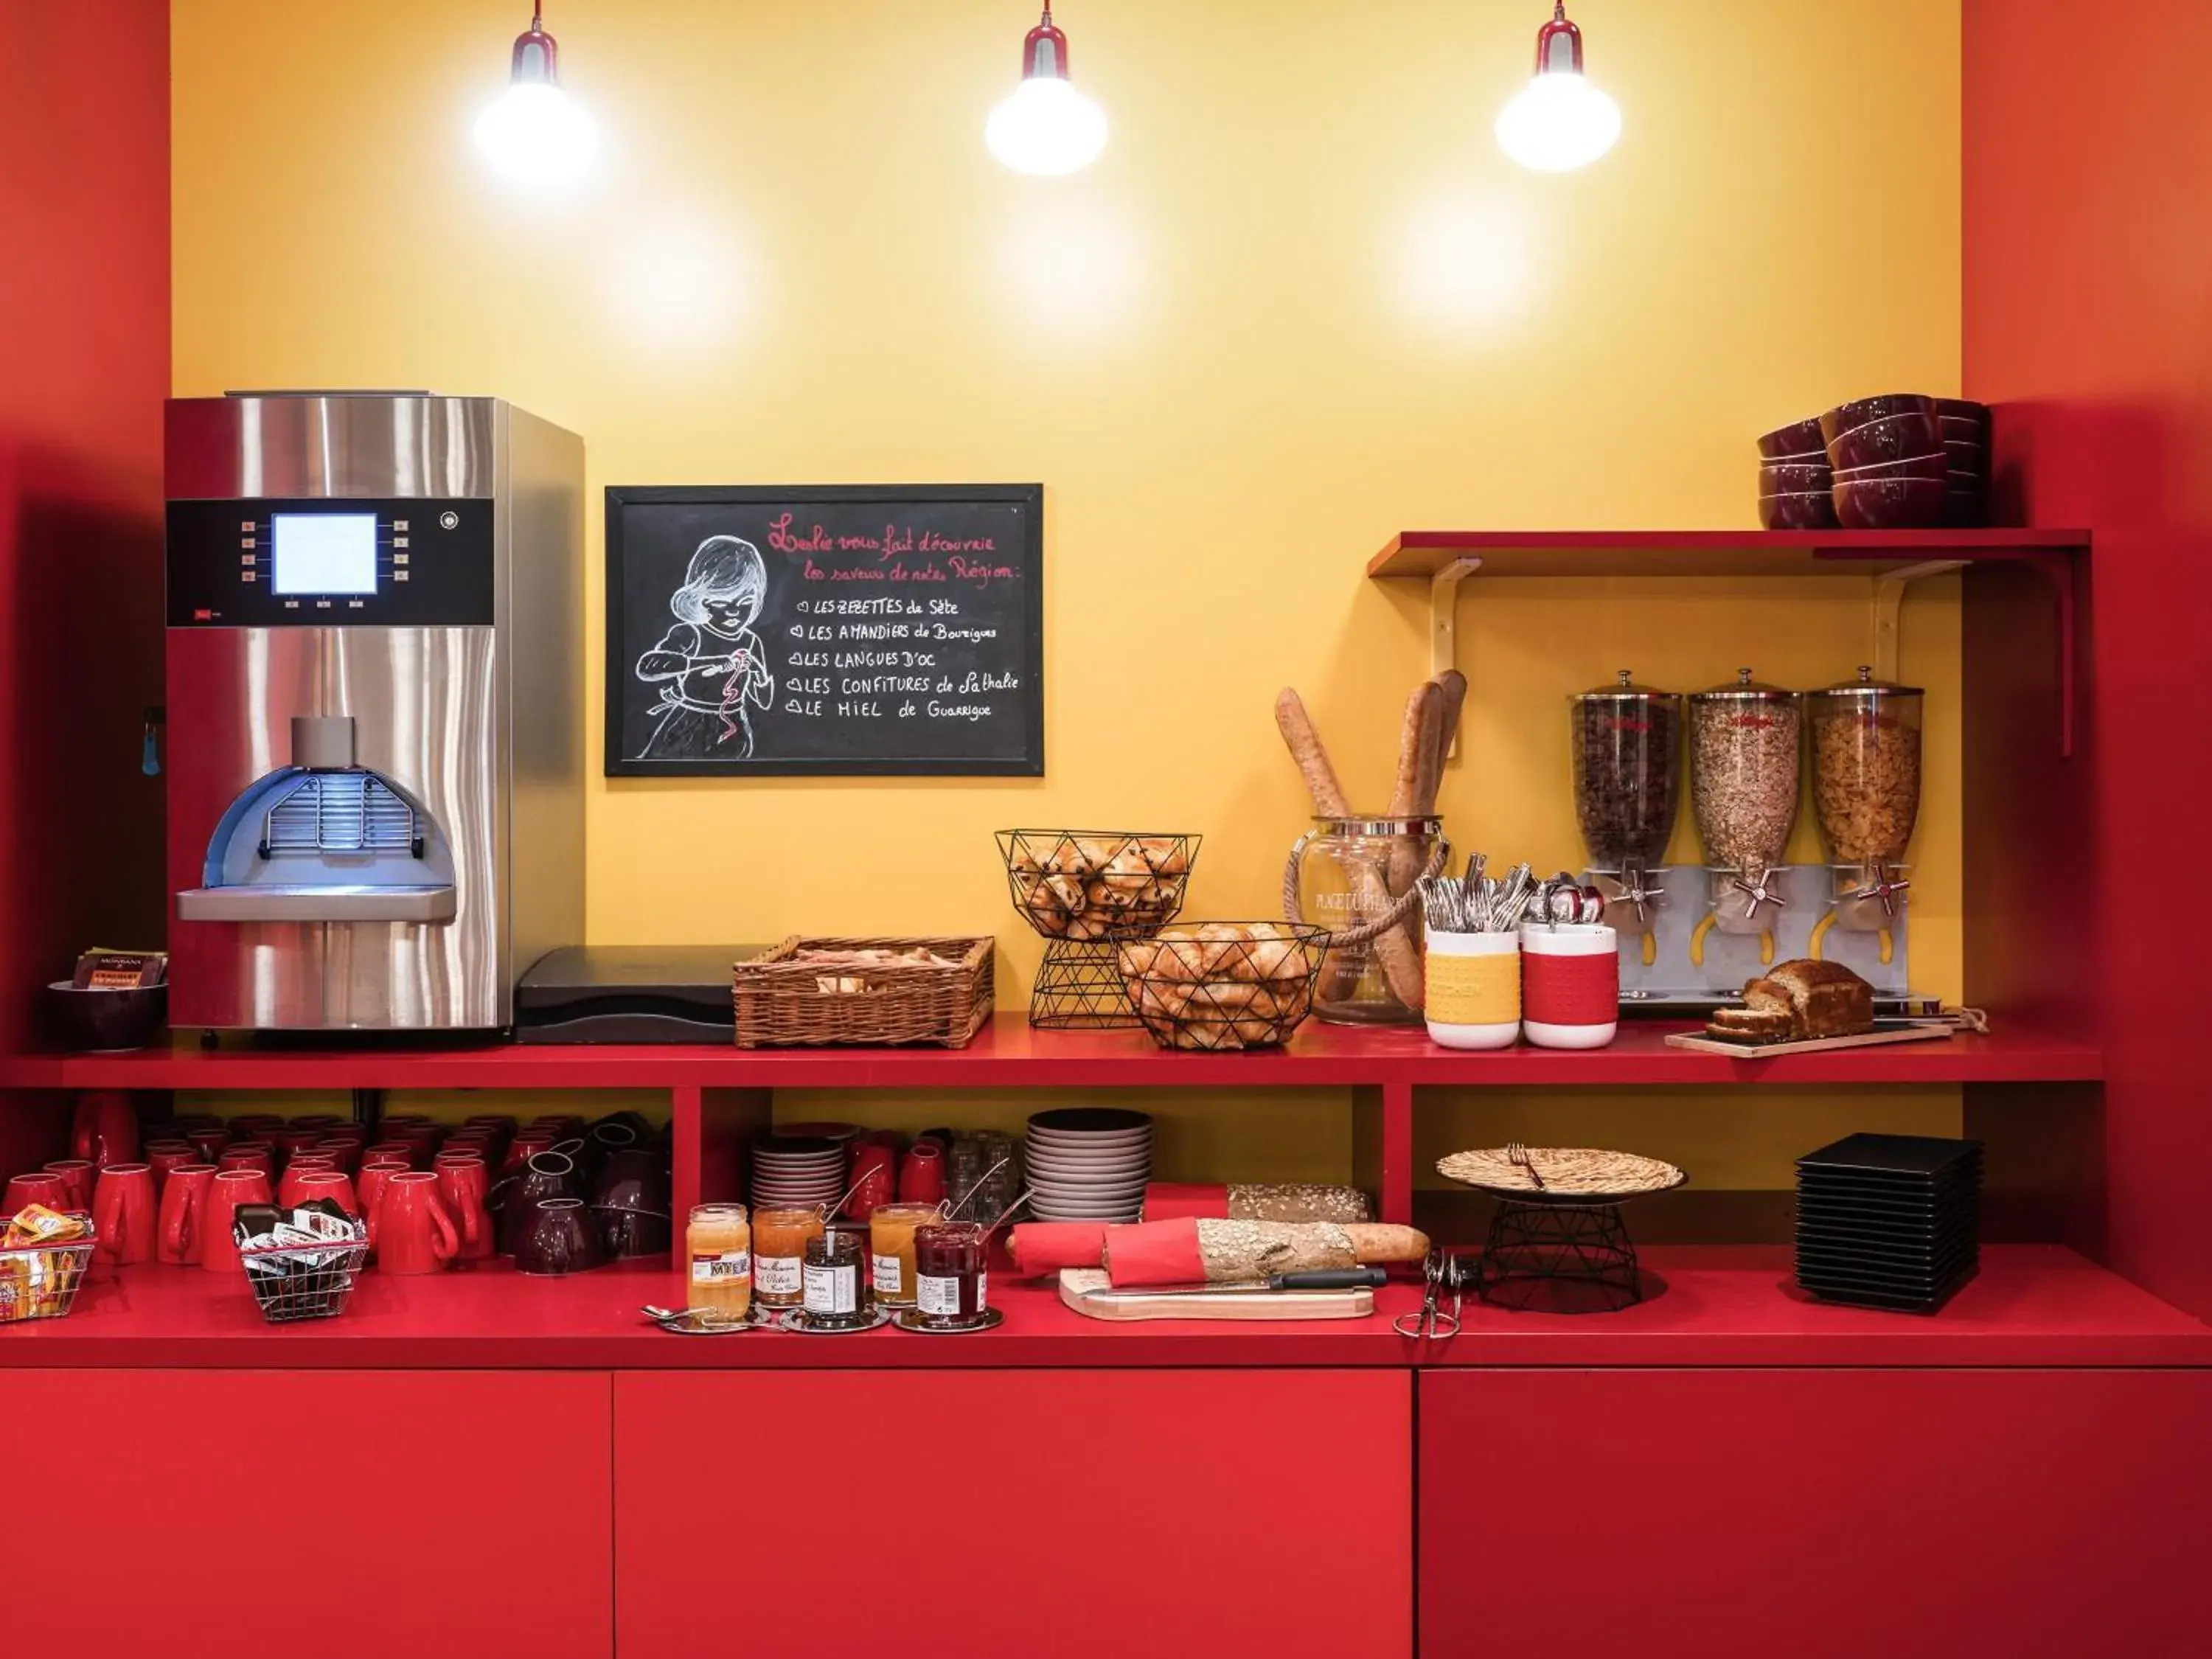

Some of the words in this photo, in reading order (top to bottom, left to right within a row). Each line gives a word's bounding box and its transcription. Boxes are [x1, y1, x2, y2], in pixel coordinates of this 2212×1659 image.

[838, 536, 878, 550] vous
[878, 524, 914, 560] fait
[804, 560, 824, 580] les
[889, 563, 907, 581] de
[814, 599, 835, 614] LES
[906, 600, 923, 614] de
[929, 599, 959, 614] Sète
[809, 625, 832, 640] LES
[914, 624, 930, 638] de
[805, 652, 828, 667] LES
[835, 651, 898, 668] LANGUES
[902, 651, 936, 667] D'OC
[806, 678, 830, 694] LES
[936, 675, 953, 693] de
[806, 701, 822, 716] LE
[899, 700, 916, 717] de
